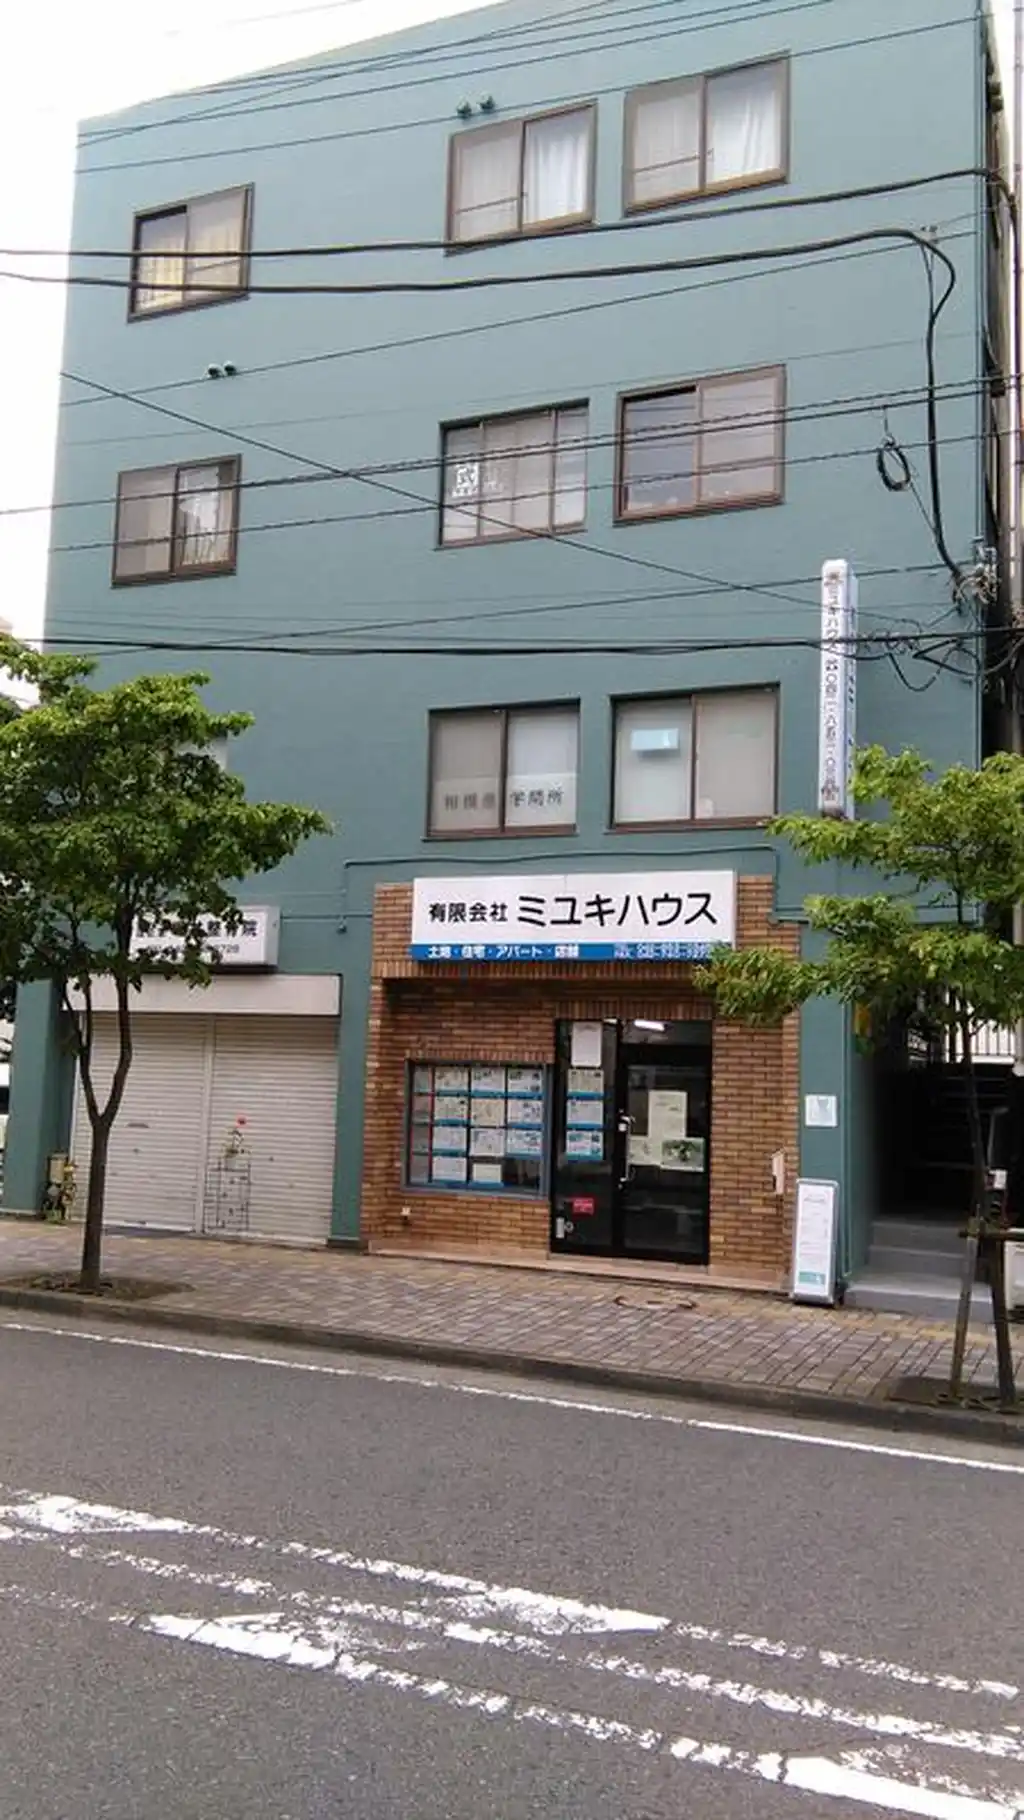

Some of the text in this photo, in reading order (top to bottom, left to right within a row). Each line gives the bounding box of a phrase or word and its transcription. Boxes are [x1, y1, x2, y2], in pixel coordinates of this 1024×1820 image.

[429, 893, 717, 927] 有限会社 ミユキハウス
